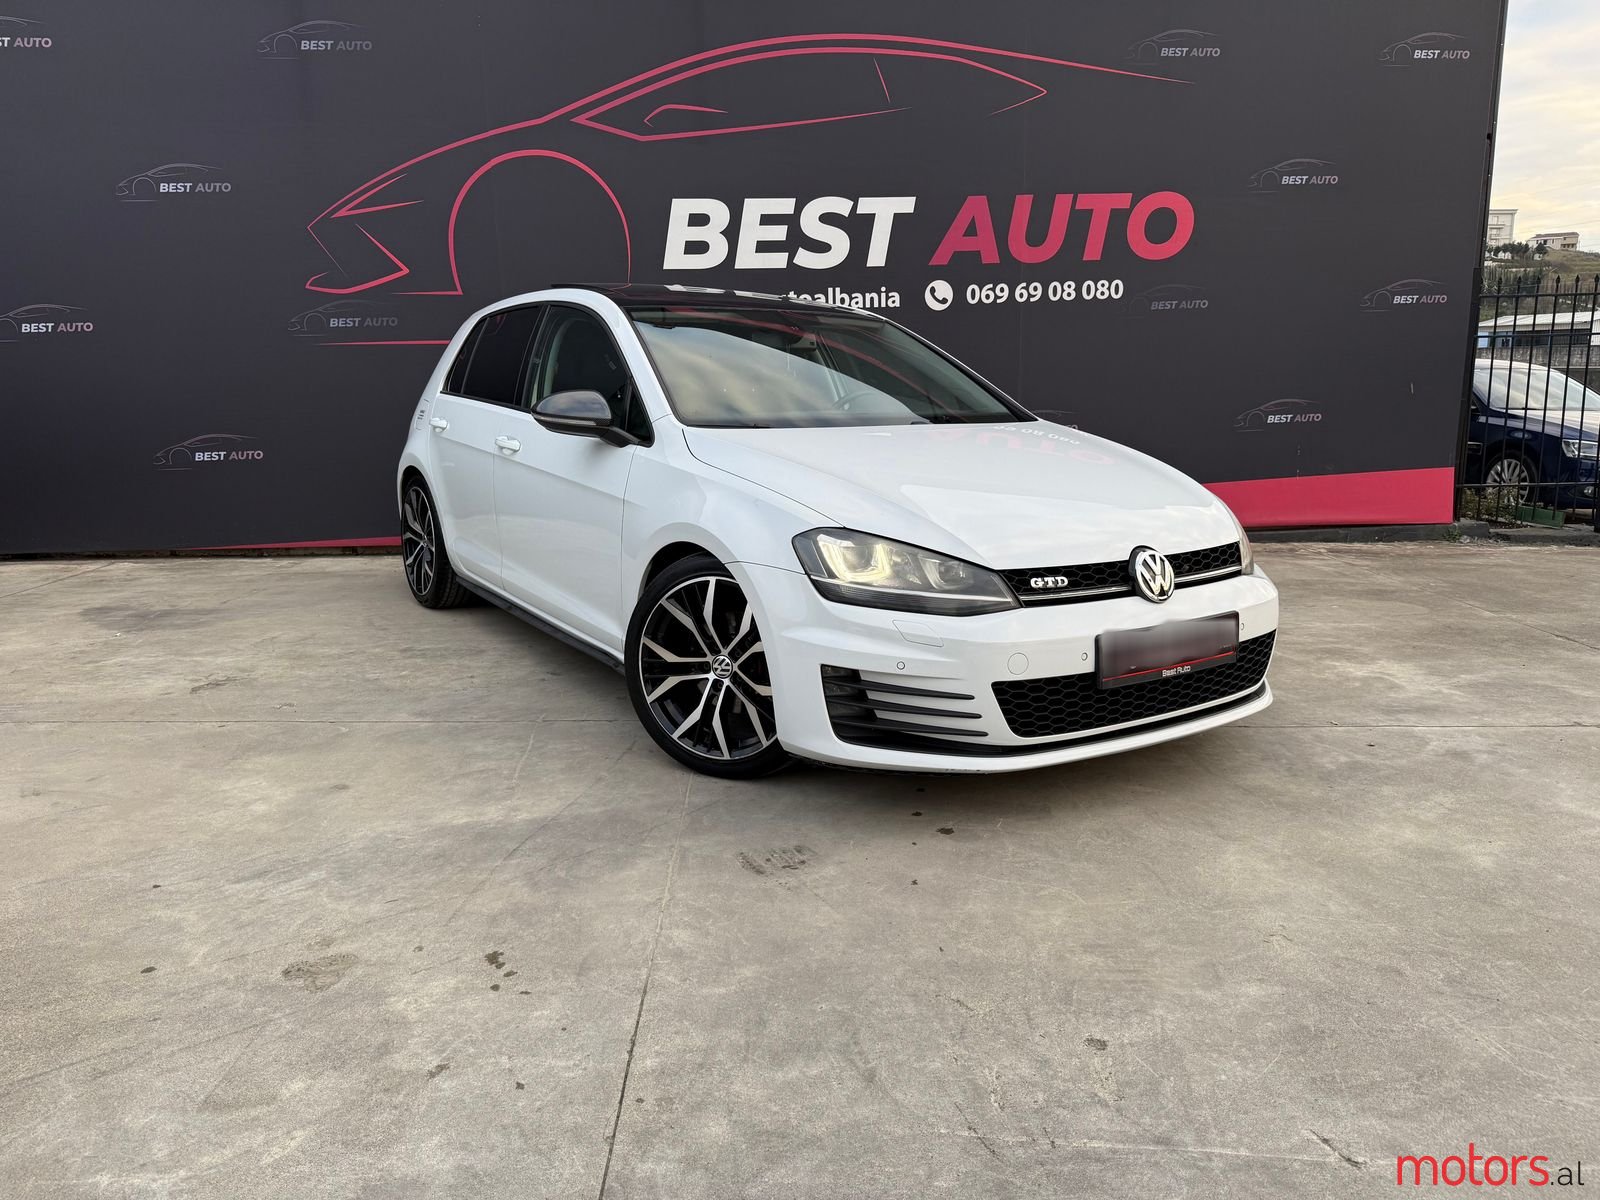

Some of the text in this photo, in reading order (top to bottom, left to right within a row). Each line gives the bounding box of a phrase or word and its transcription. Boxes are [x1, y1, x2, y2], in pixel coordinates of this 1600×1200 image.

[13, 36, 52, 48] AUTO
[300, 40, 372, 51] BEST AUTO
[1160, 47, 1221, 57] BEST AUTO
[1413, 49, 1471, 60] BEST AUTO
[1281, 174, 1339, 185] BEST AUTO
[159, 182, 232, 193] BEST AUTO
[663, 191, 1195, 270] BEST AUTO
[966, 284, 1010, 305] 069
[1014, 282, 1043, 303] 69
[1047, 281, 1077, 301] 08
[1081, 279, 1125, 300] 080
[1150, 299, 1209, 311] BEST AUTO
[1392, 294, 1448, 305] BEST AUTO
[21, 321, 94, 333] BEST AUTO
[329, 317, 398, 328] BEST AUTO
[1266, 413, 1323, 424] BEST AUTO
[194, 450, 264, 462] BEST AUTO
[1030, 576, 1069, 589] GTD
[1162, 665, 1191, 677] Best Auto
